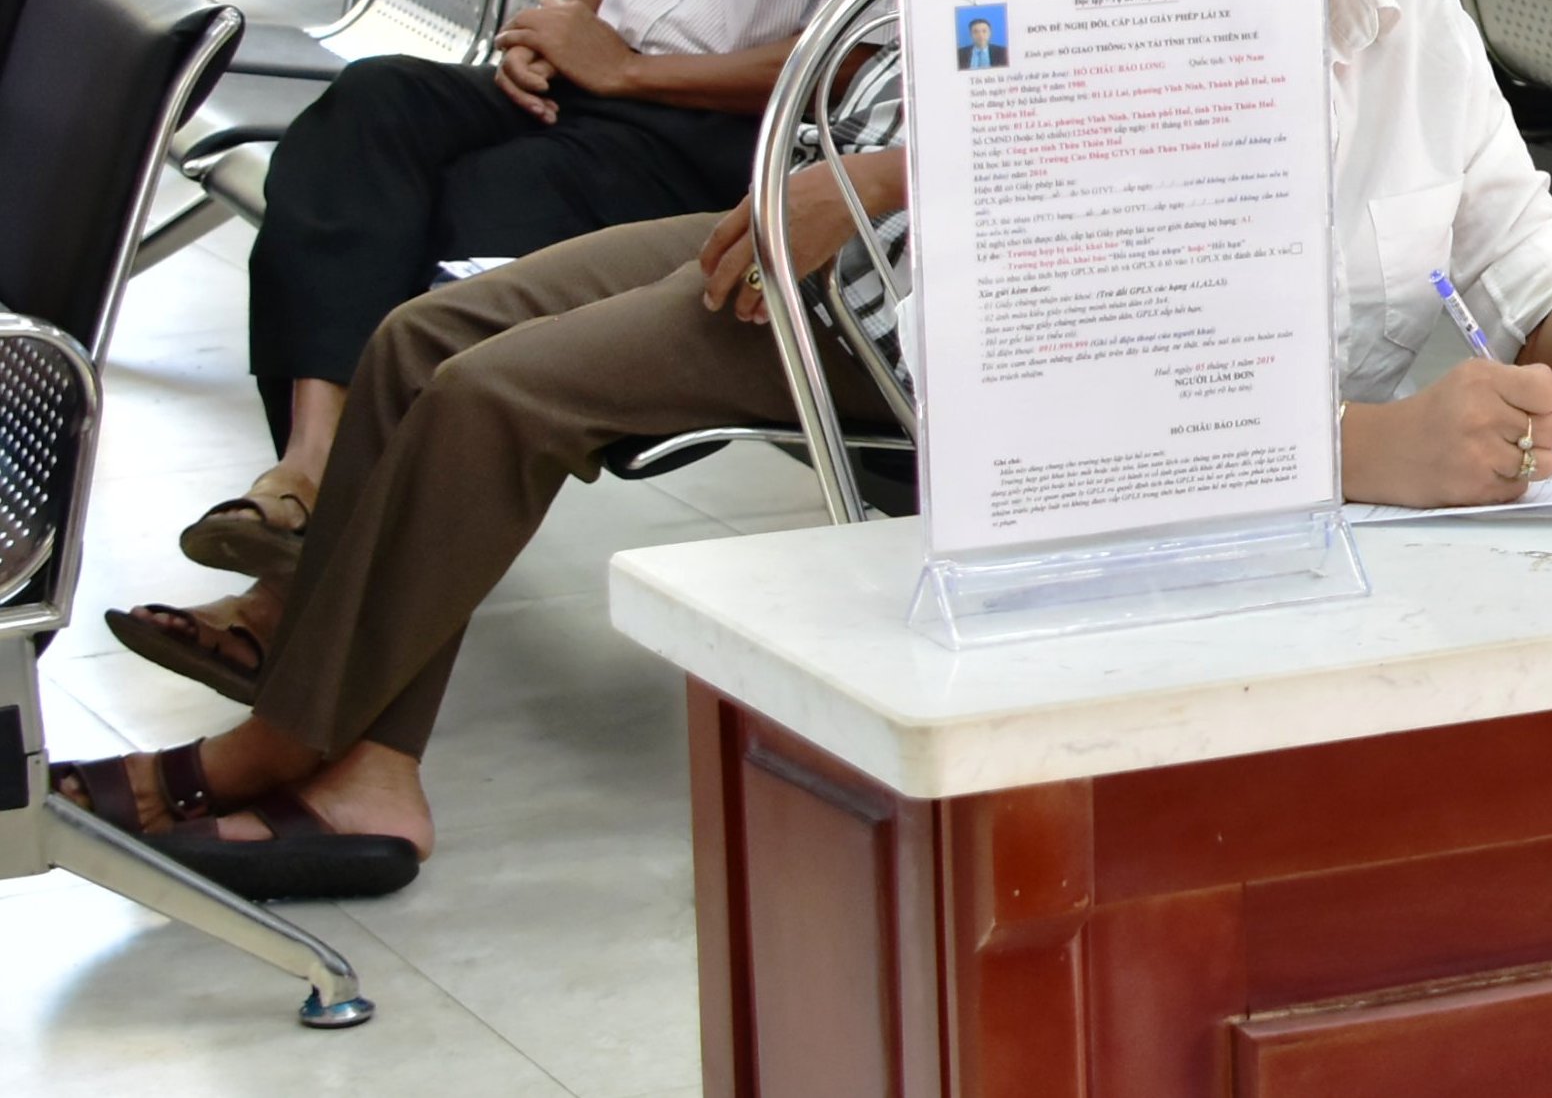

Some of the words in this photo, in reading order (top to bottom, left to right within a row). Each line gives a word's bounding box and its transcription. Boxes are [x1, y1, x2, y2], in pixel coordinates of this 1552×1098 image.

[1218, 10, 1230, 18] XE
[1174, 374, 1207, 386] NGƯỜI
[1209, 371, 1231, 382] LÀM
[1233, 370, 1254, 379] ĐƠN
[1185, 422, 1212, 433] CHÂU
[1235, 417, 1260, 427] LONG
